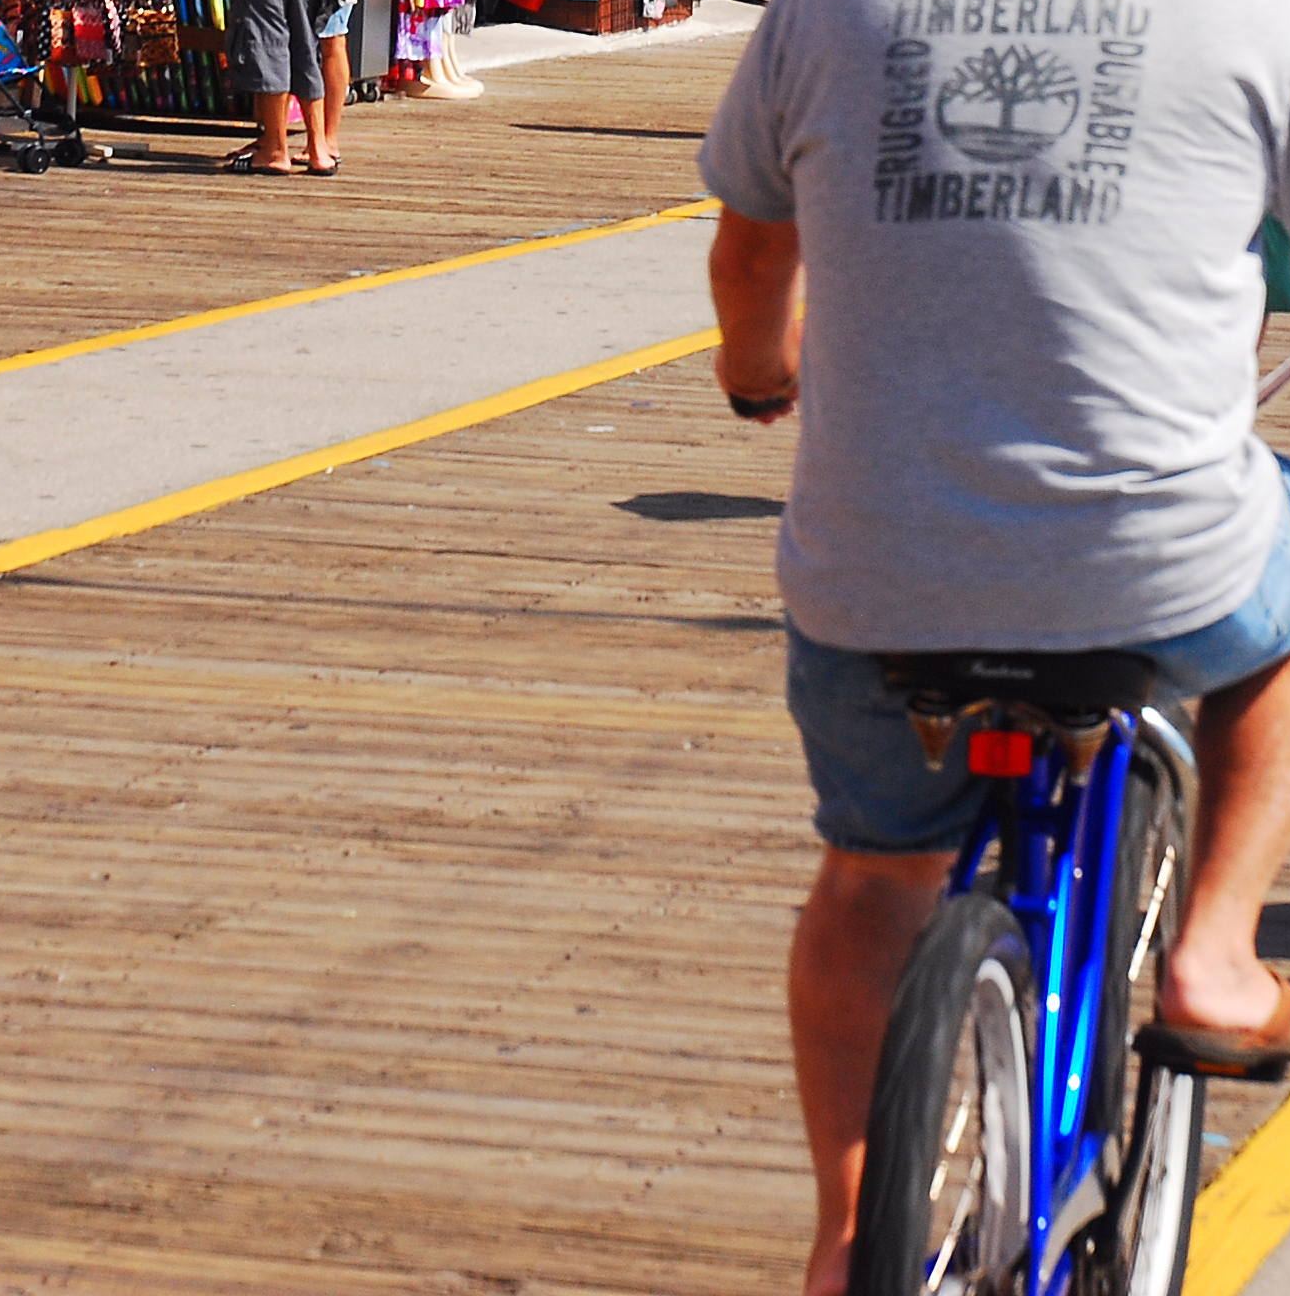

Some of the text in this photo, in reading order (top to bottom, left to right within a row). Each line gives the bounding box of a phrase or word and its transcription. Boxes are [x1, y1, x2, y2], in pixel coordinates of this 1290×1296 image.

[875, 38, 932, 178] RUGGED
[1075, 38, 1145, 182] DURABLE
[873, 171, 1122, 224] TIMBERLAND
